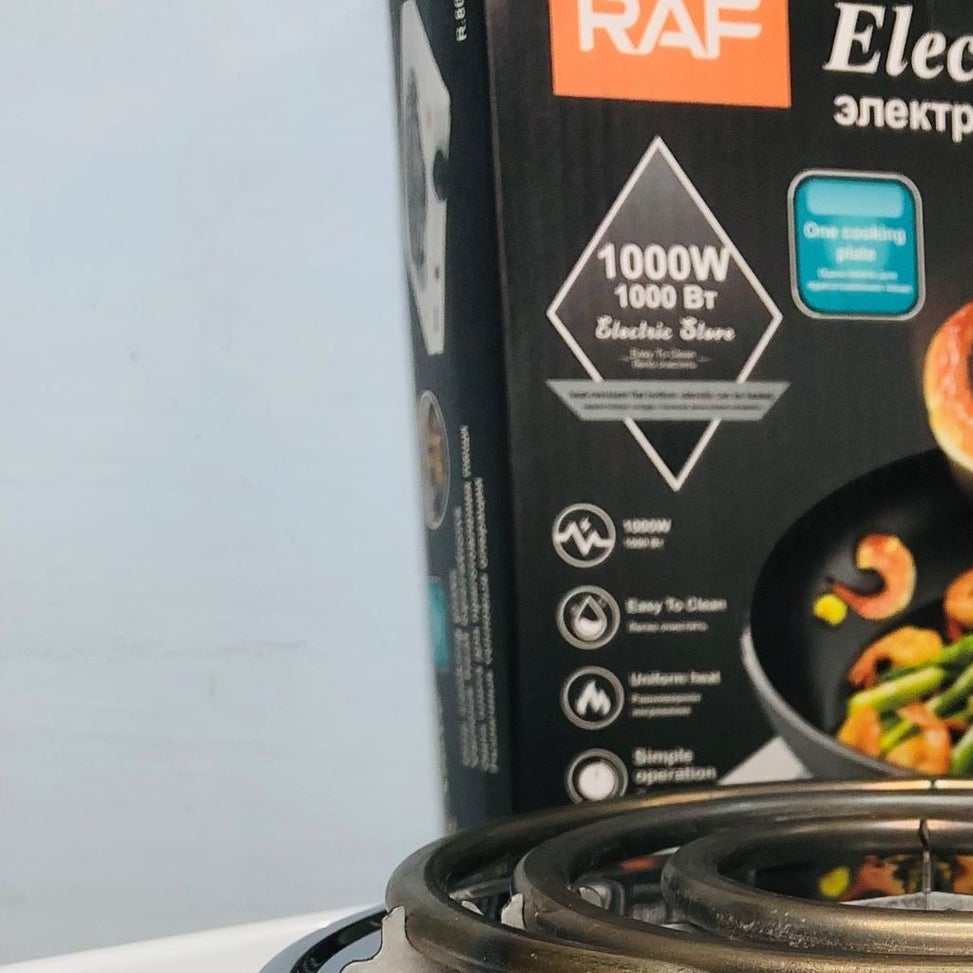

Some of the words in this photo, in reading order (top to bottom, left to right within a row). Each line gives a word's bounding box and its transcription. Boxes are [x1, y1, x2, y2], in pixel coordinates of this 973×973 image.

[577, 0, 763, 60] RAF
[597, 243, 730, 282] 1000W
[614, 282, 677, 309] 1000
[595, 314, 673, 340] Electric
